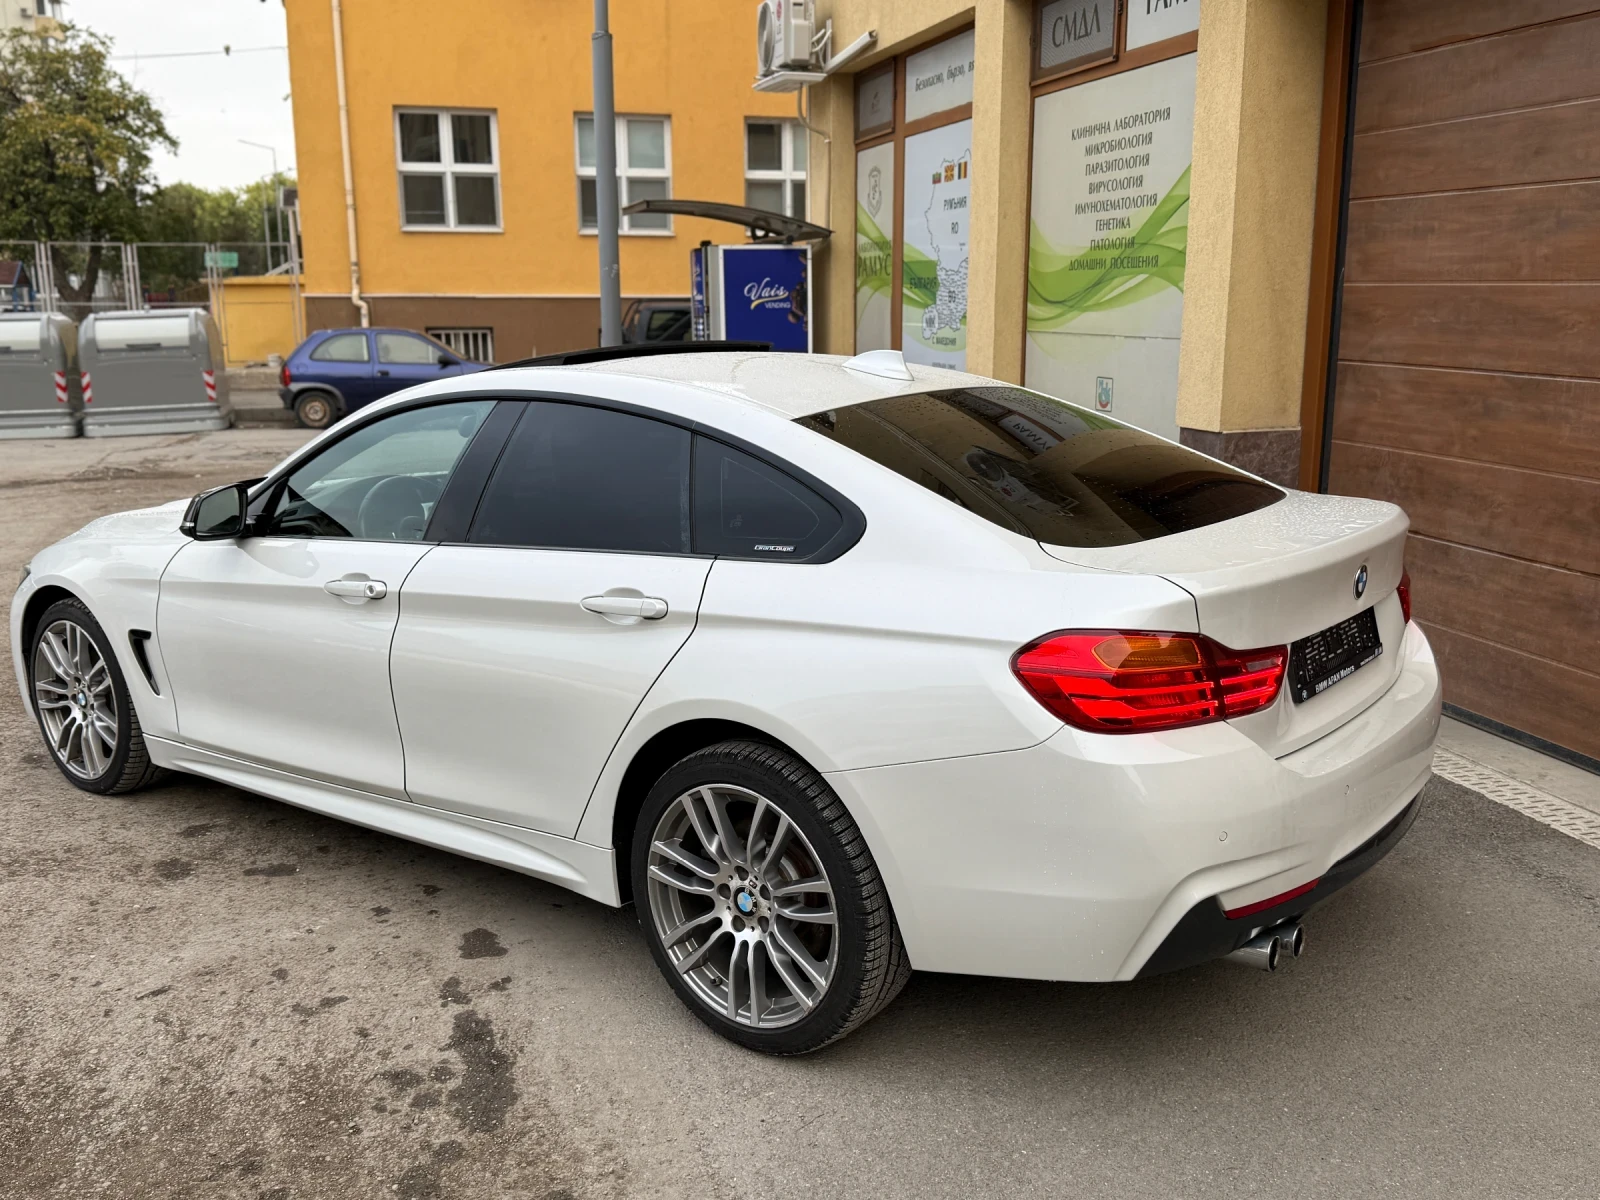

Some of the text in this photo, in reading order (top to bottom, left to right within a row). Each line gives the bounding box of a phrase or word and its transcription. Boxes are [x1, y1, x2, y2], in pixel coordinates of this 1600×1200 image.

[1052, 3, 1101, 48] СМДЛ
[1071, 106, 1171, 141] КЛИНИЧНА ЛАБОРАТОРИЯ
[1084, 131, 1153, 157] МИКРОБИОЛОГИЯ
[1085, 153, 1150, 176] ПАРАЗИТОЛОГИЯ
[1088, 174, 1144, 195] ВИРУСОЛОГИЯ
[943, 196, 967, 211] РУМЪНИЯ
[1074, 193, 1158, 215] ИМУНОХЕМАТОЛОГИЯ
[951, 222, 959, 234] RO
[1095, 216, 1131, 232] ГЕНЕТИКА
[1090, 236, 1136, 251] ПАТОЛОГИЯ
[858, 253, 891, 277] РАМУС
[1068, 258, 1107, 271] ДОМАШНИ
[743, 277, 789, 301] Vais
[764, 301, 792, 309] VENDING
[1315, 680, 1328, 693] BMW
[1340, 665, 1355, 680] Motors
